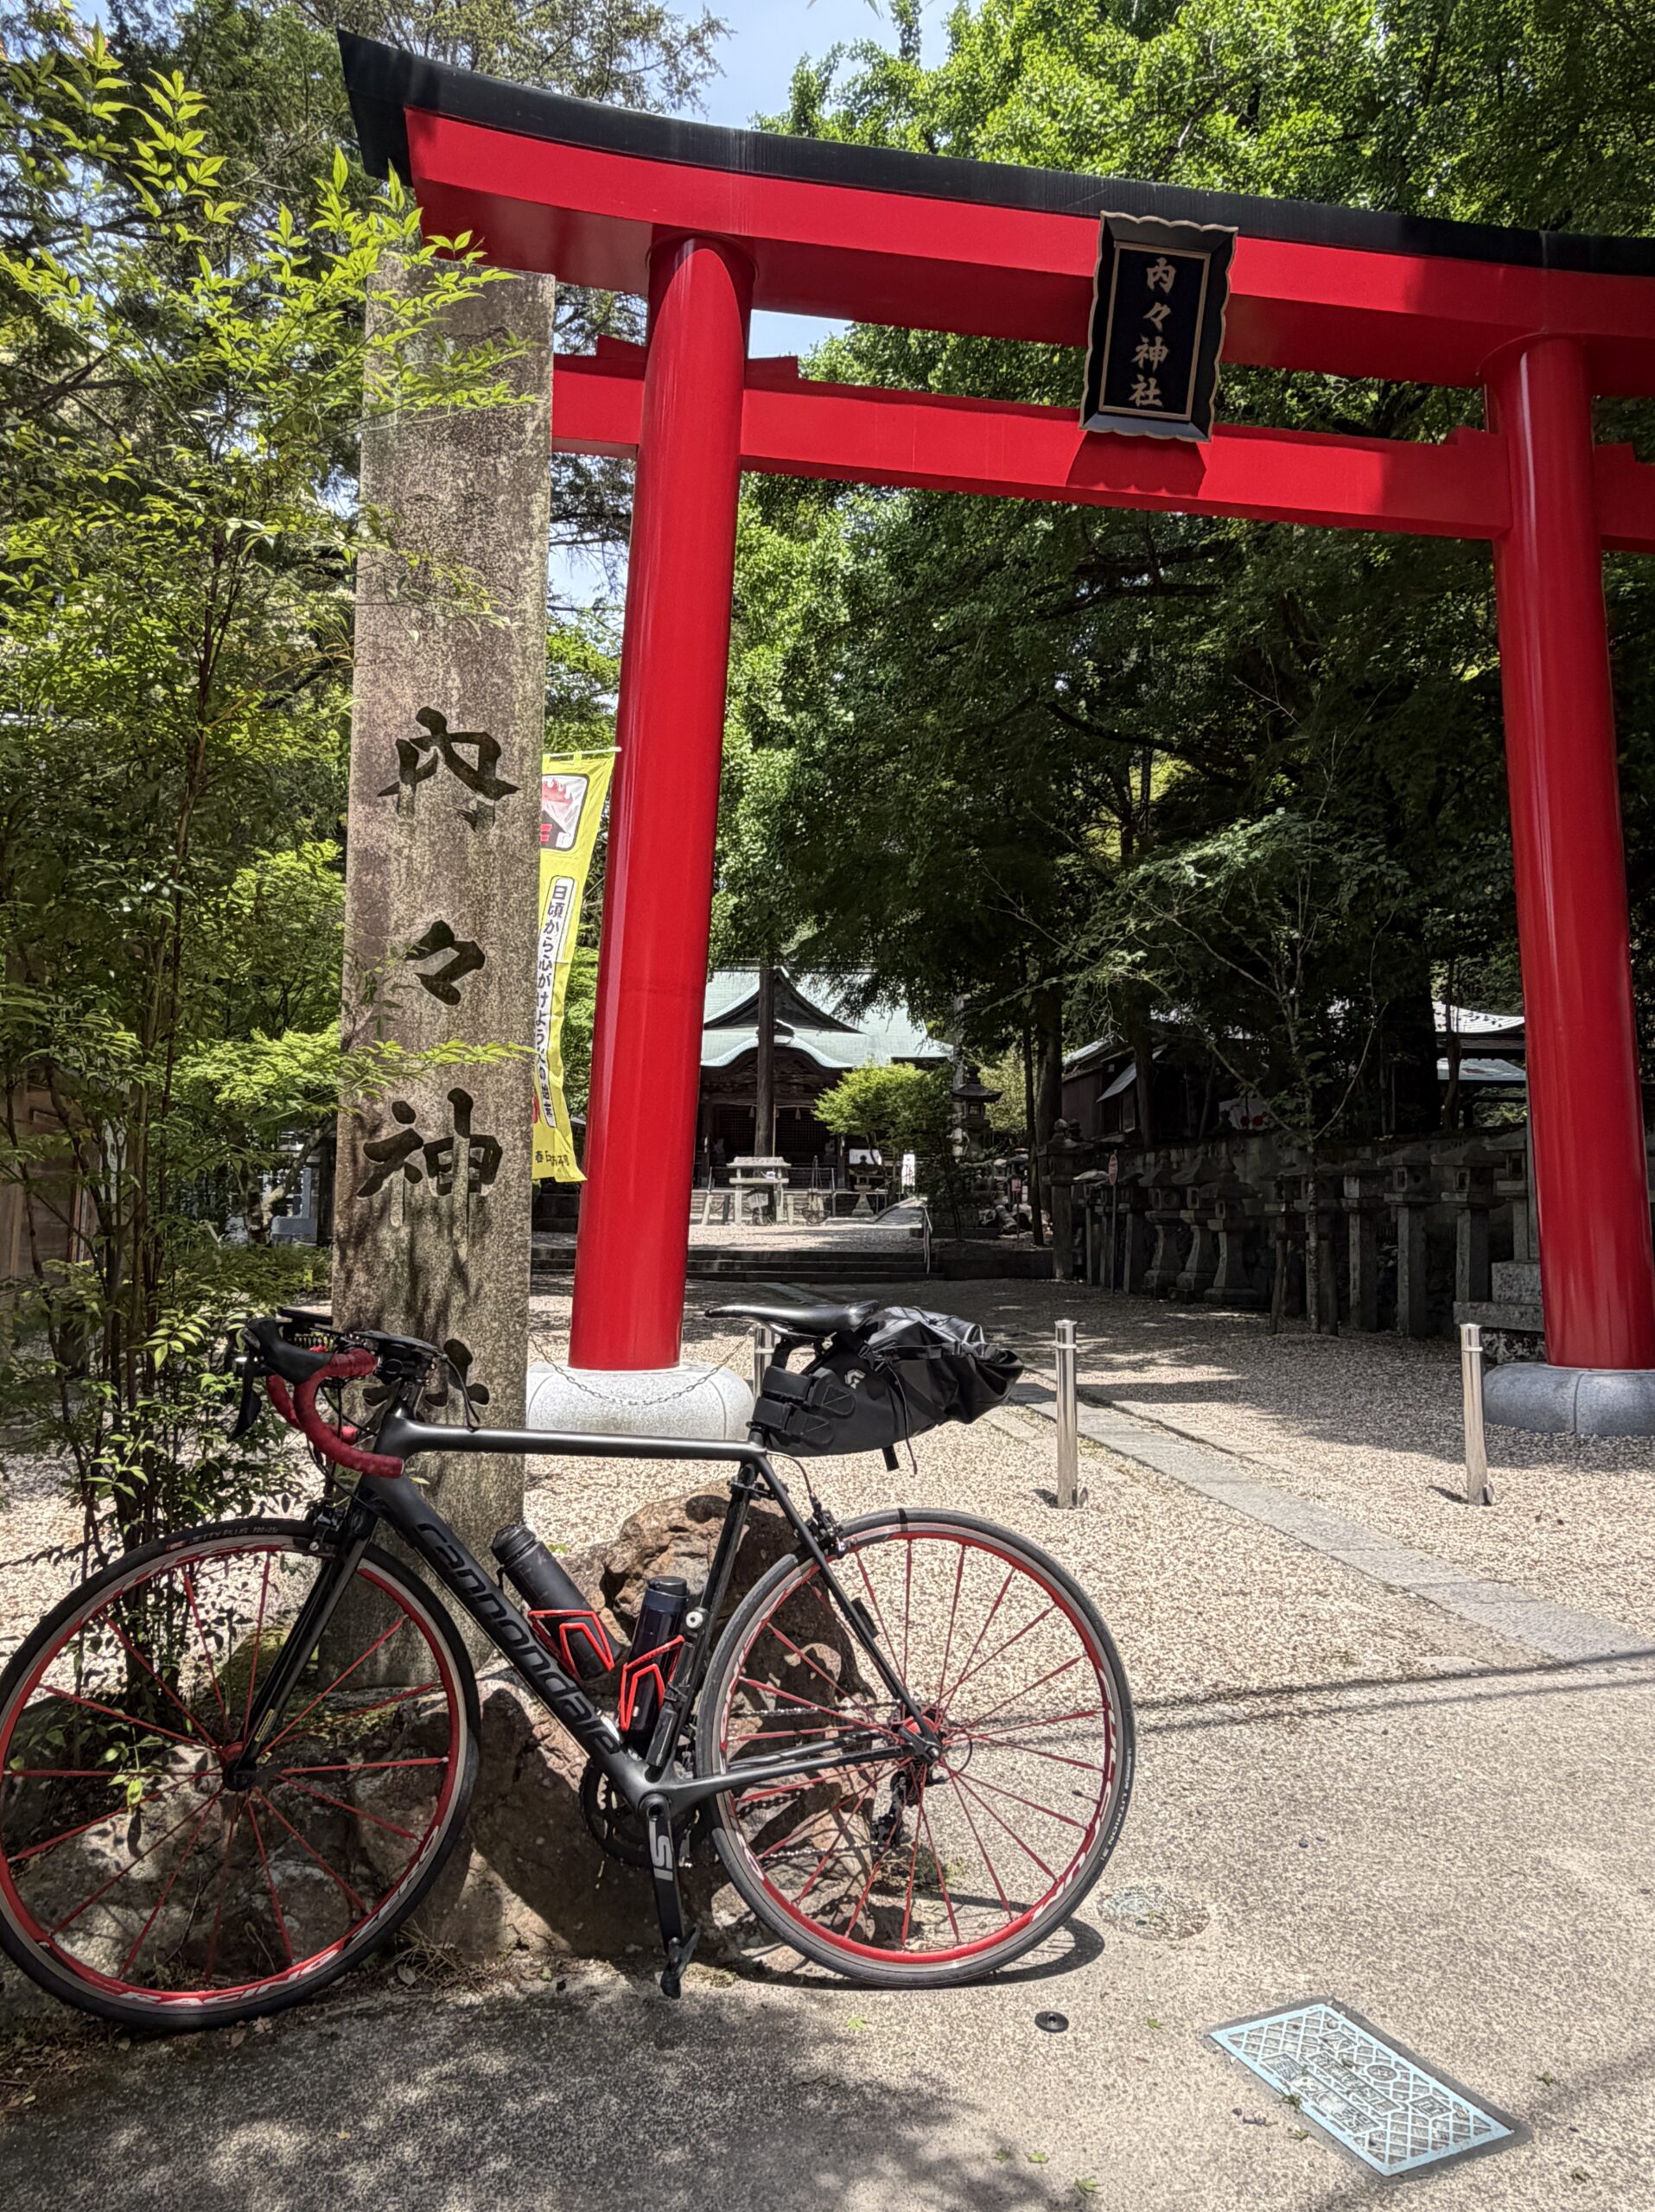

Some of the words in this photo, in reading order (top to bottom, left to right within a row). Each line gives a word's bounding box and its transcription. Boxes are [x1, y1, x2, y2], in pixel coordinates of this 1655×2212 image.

[1128, 257, 1176, 408] 内々神社
[356, 706, 521, 1434] 内々神
